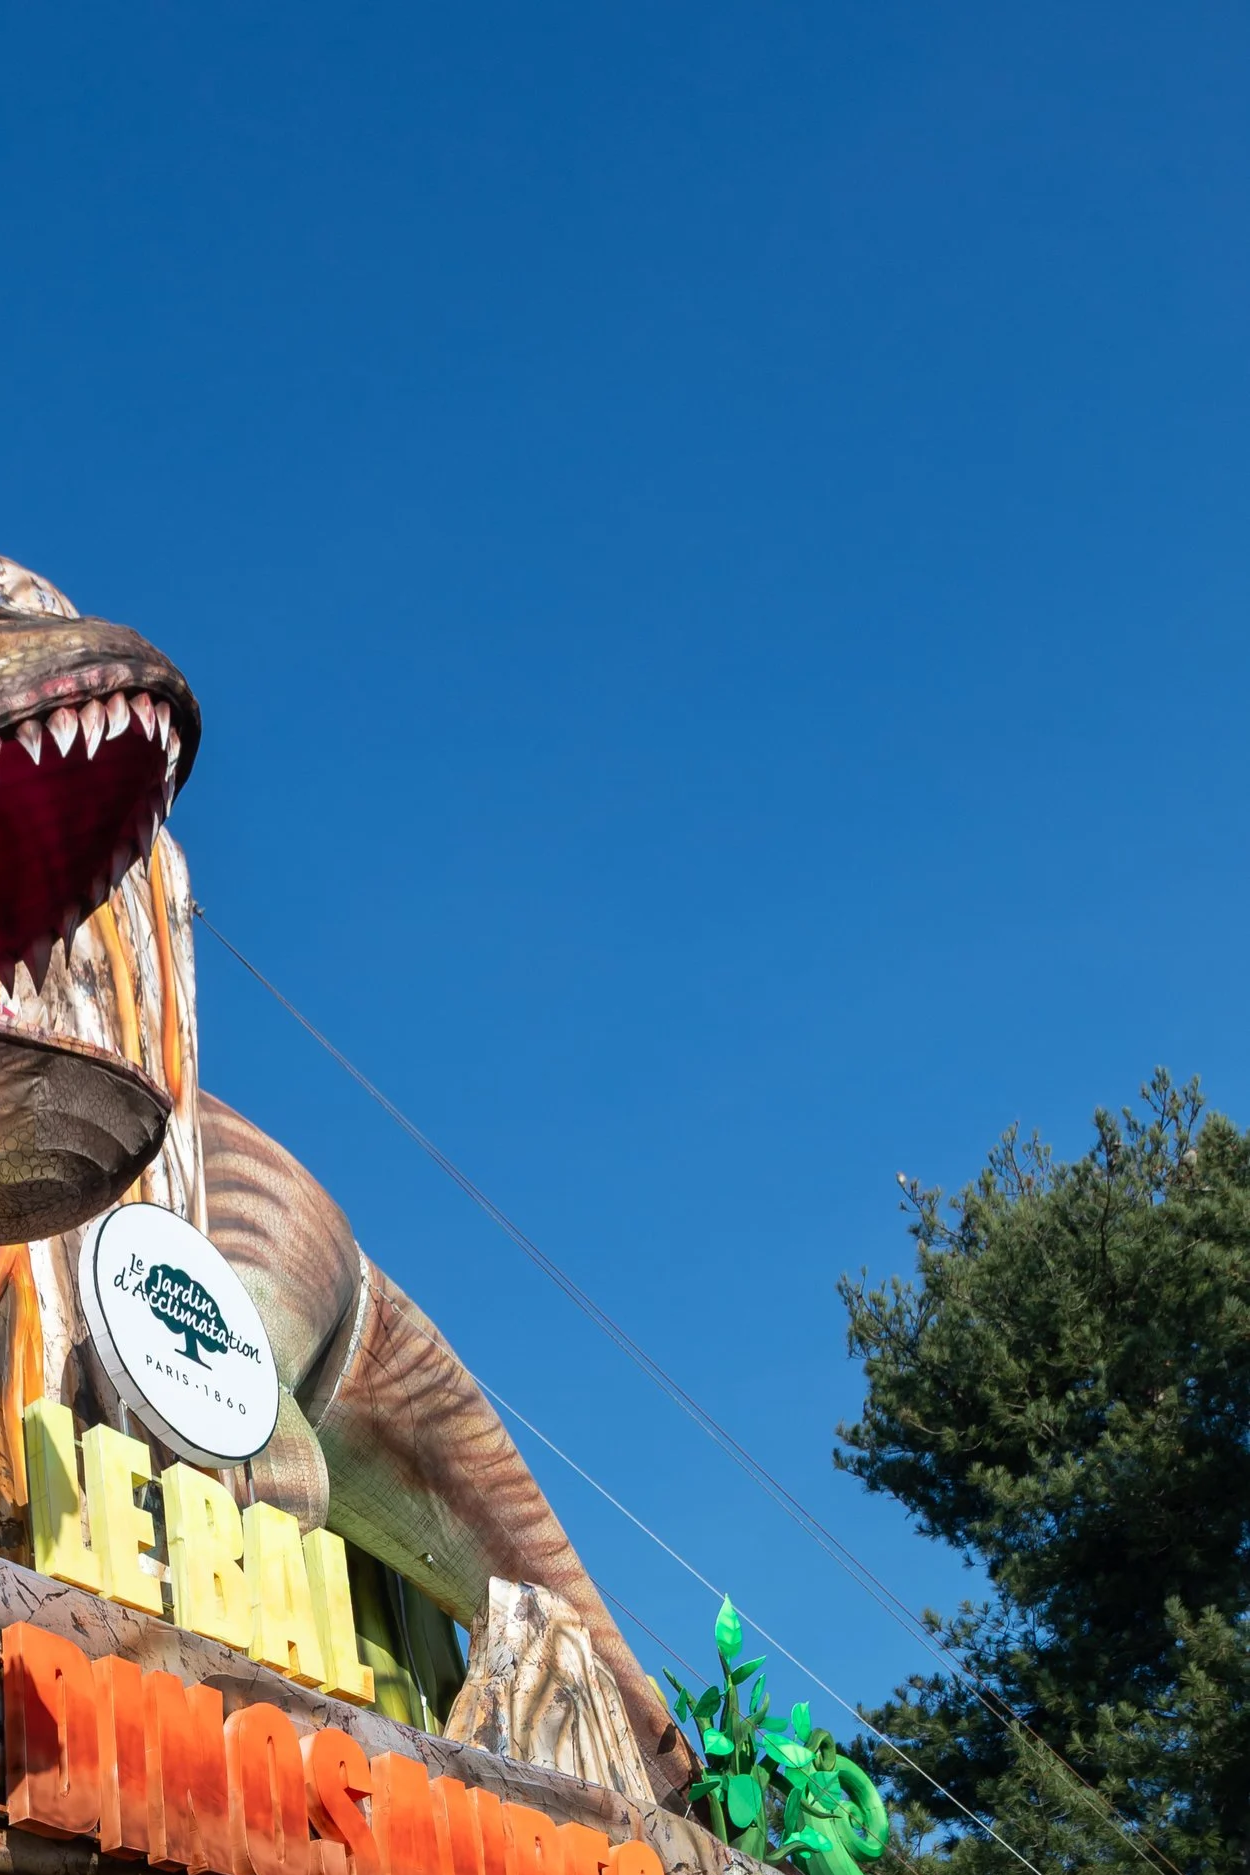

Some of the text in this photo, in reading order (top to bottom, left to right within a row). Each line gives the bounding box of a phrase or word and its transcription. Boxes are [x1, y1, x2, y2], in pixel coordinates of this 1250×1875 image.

[113, 1267, 262, 1364] d'Acclimatation
[129, 1253, 217, 1318] Le Jardin
